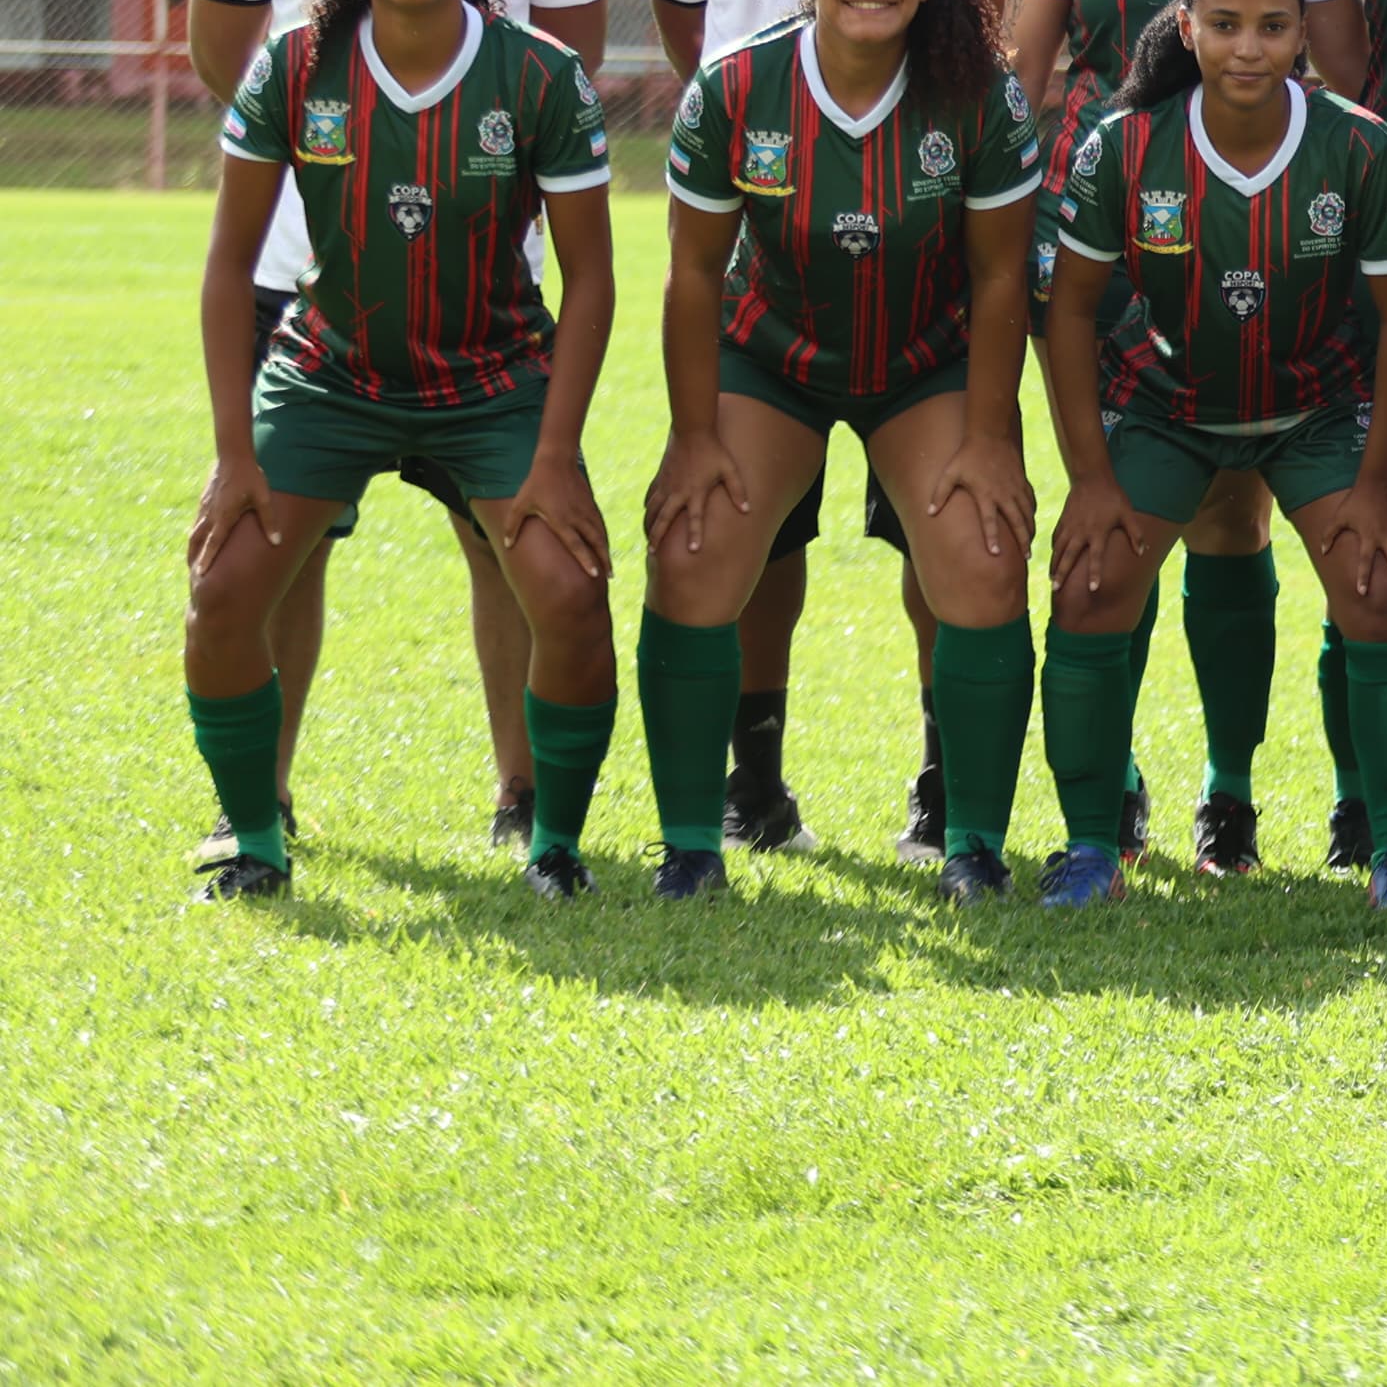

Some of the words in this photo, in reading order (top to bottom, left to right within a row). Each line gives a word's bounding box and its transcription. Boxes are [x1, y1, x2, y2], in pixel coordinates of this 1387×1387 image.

[391, 184, 428, 198] COPA
[836, 213, 874, 225] COPA
[1224, 271, 1261, 281] COPA
